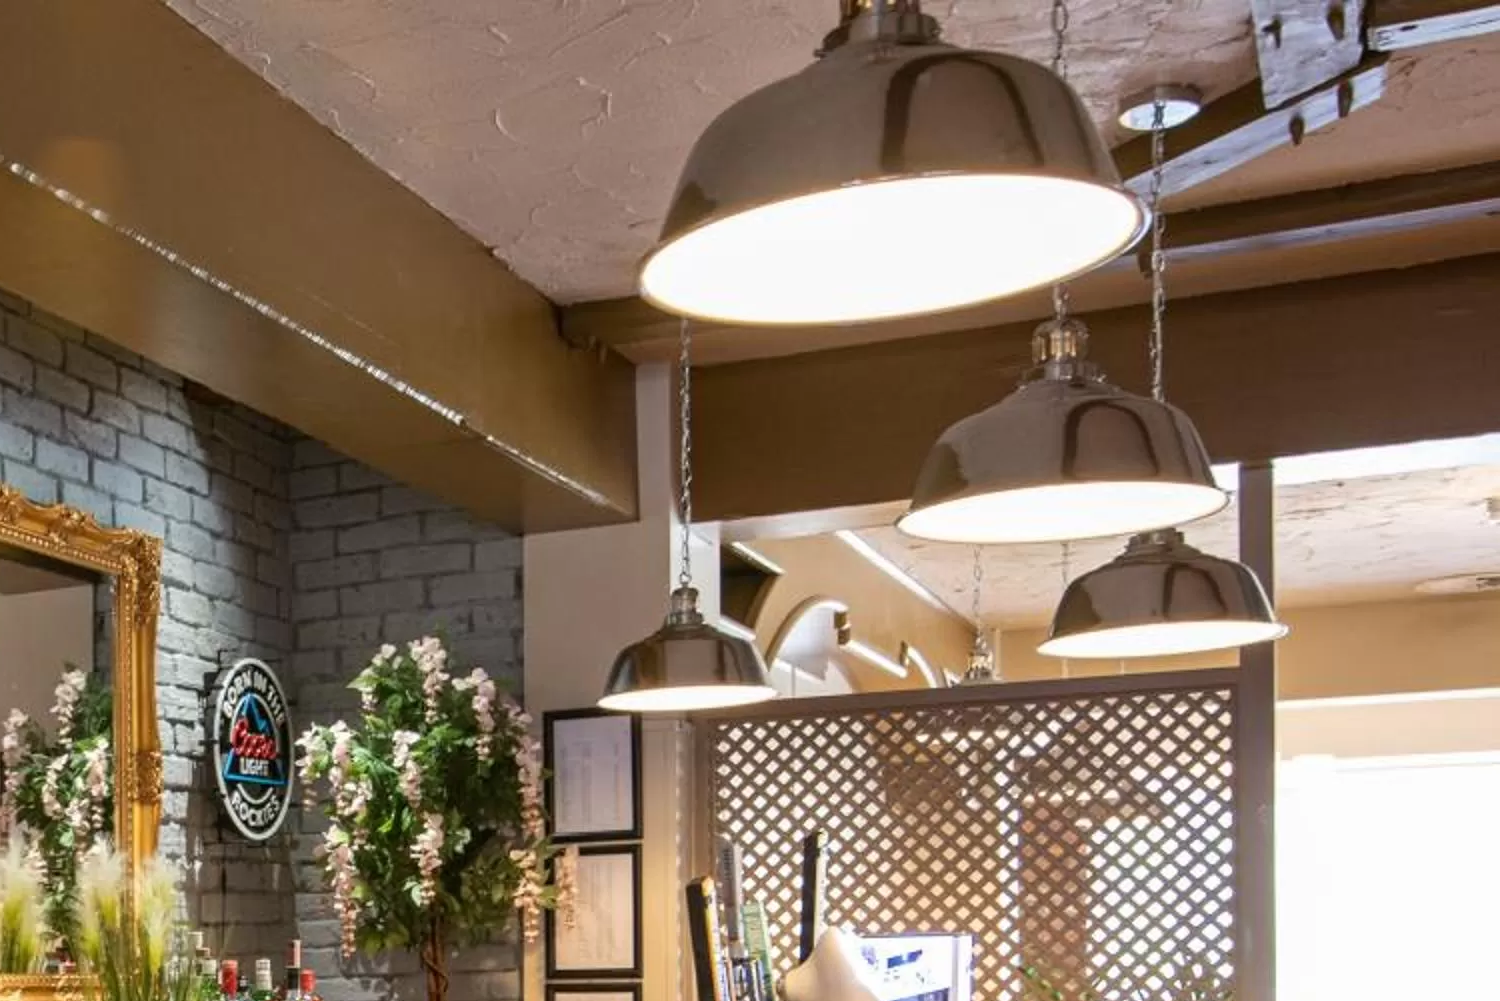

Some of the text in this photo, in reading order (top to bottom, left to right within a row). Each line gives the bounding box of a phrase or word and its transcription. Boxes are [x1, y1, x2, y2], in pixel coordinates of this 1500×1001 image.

[223, 669, 285, 727] BORN IN THE
[231, 790, 280, 827] ROCKIES
